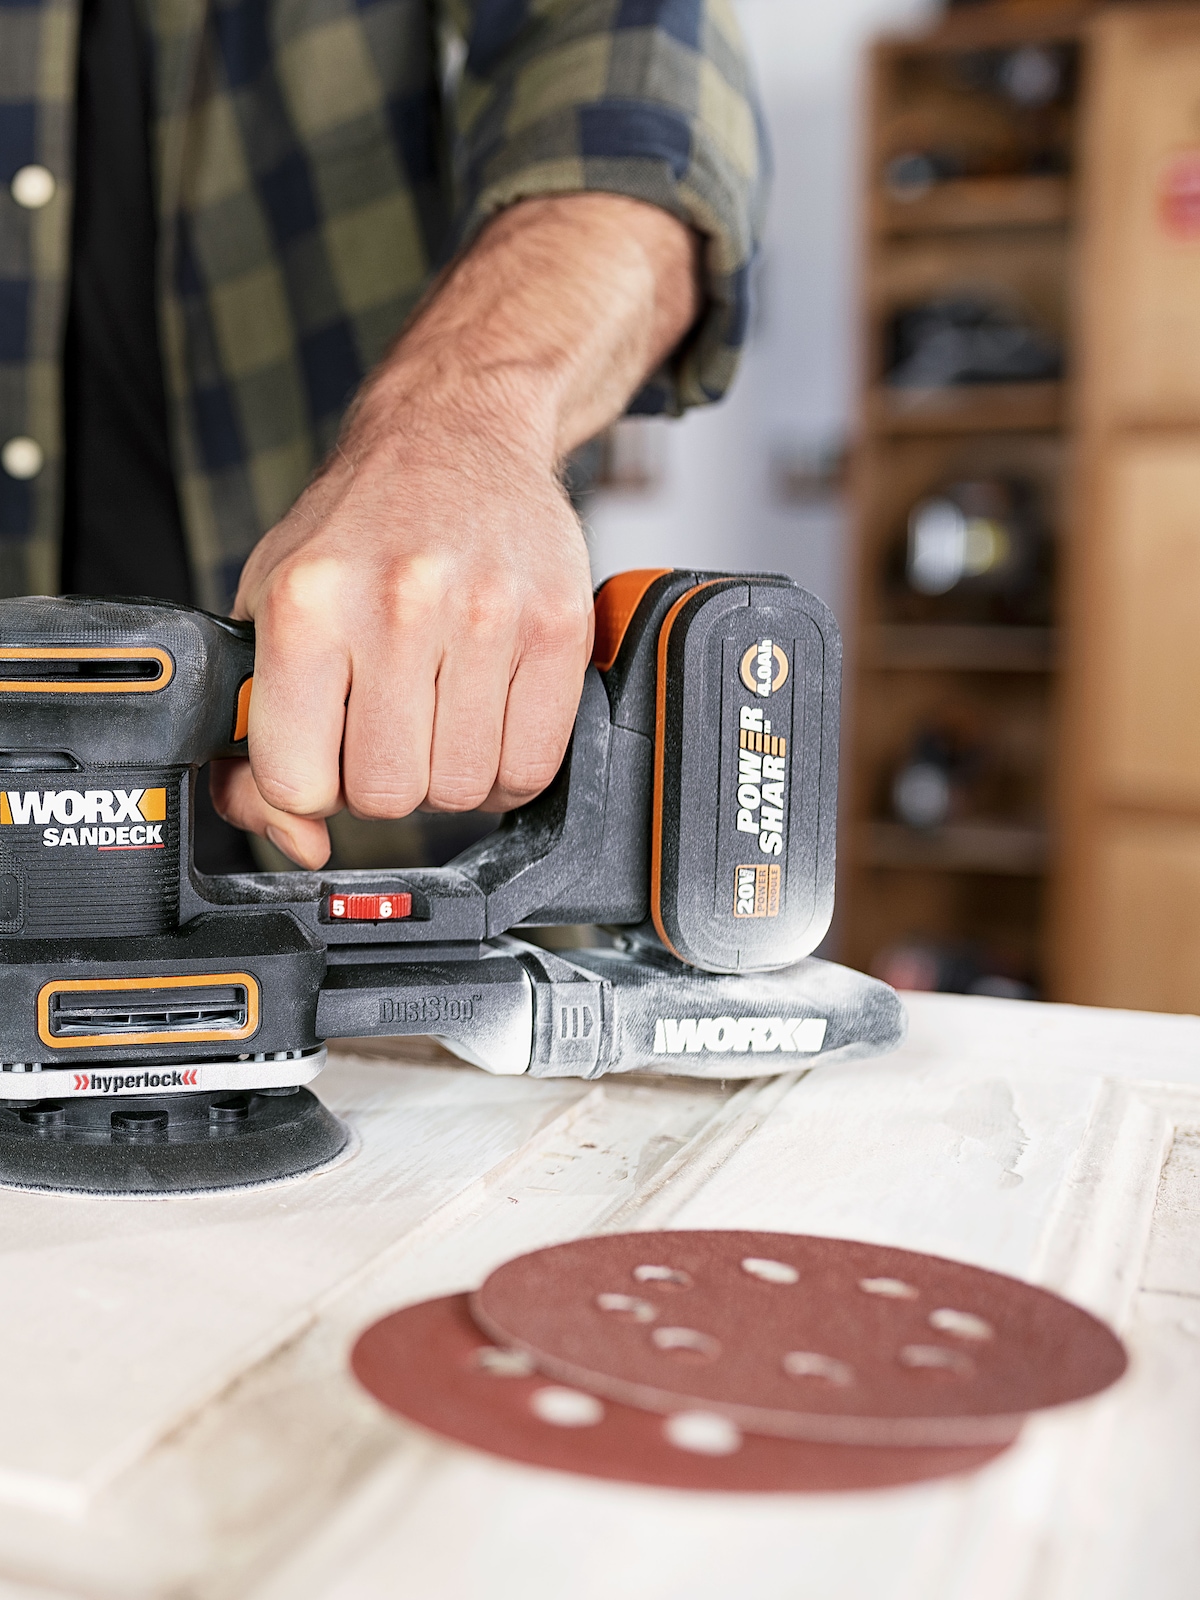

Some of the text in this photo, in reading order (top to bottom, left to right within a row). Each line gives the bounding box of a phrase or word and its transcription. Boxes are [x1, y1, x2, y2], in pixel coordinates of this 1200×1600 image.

[757, 639, 772, 697] 4.0Ah
[737, 705, 763, 834] POWER
[7, 789, 146, 825] WORX
[42, 825, 163, 847] SANDECK
[332, 899, 393, 918] 5 6
[737, 868, 755, 914] 20V
[757, 869, 767, 912] POWER
[769, 869, 779, 912] MODULE
[664, 1015, 803, 1054] WORX
[90, 1070, 183, 1093] hyperlock
